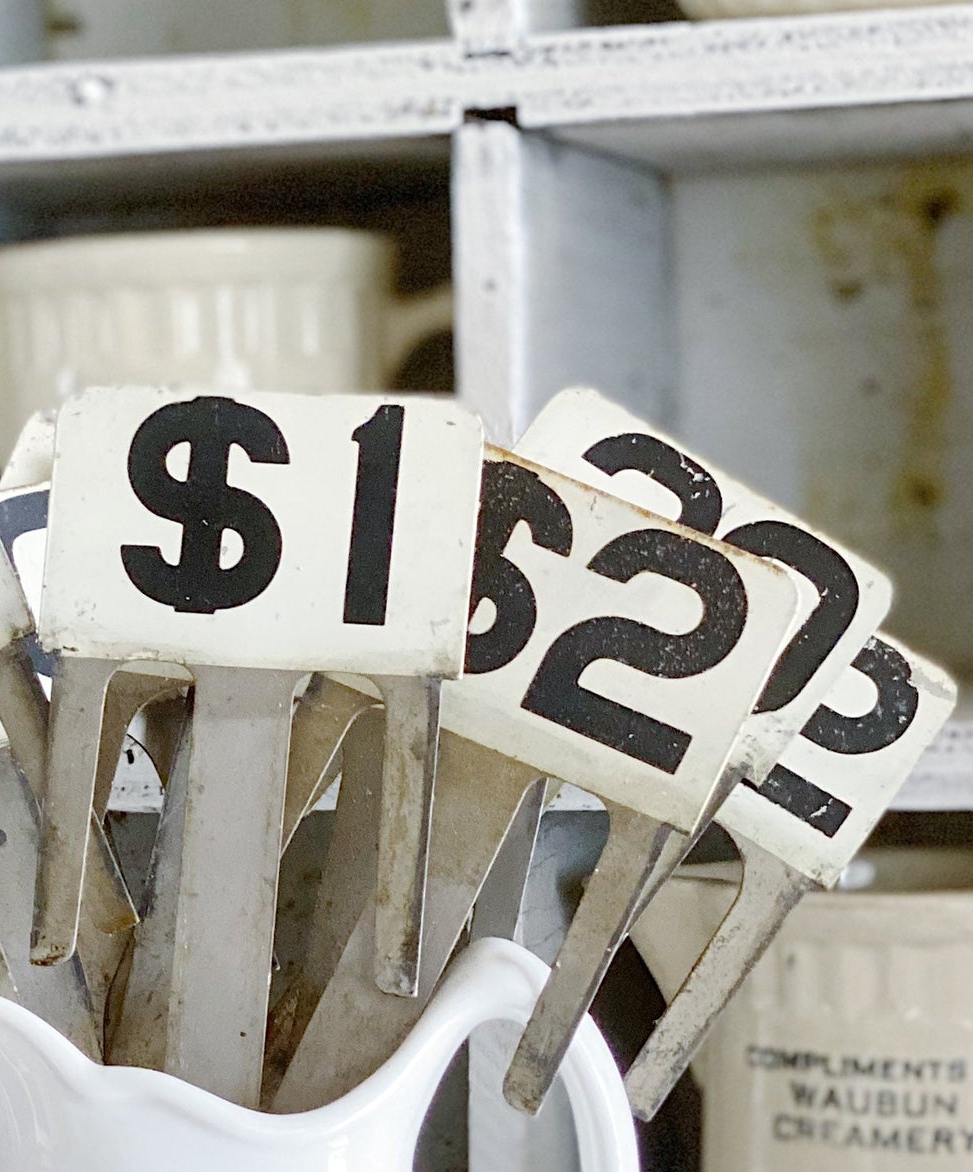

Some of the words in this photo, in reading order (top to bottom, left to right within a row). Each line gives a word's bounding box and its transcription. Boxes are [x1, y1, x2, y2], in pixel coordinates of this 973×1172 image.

[746, 1045, 968, 1081] COMPLIMENTS
[789, 1081, 958, 1117] WAUBUN
[773, 1112, 973, 1153] CREAMERY
